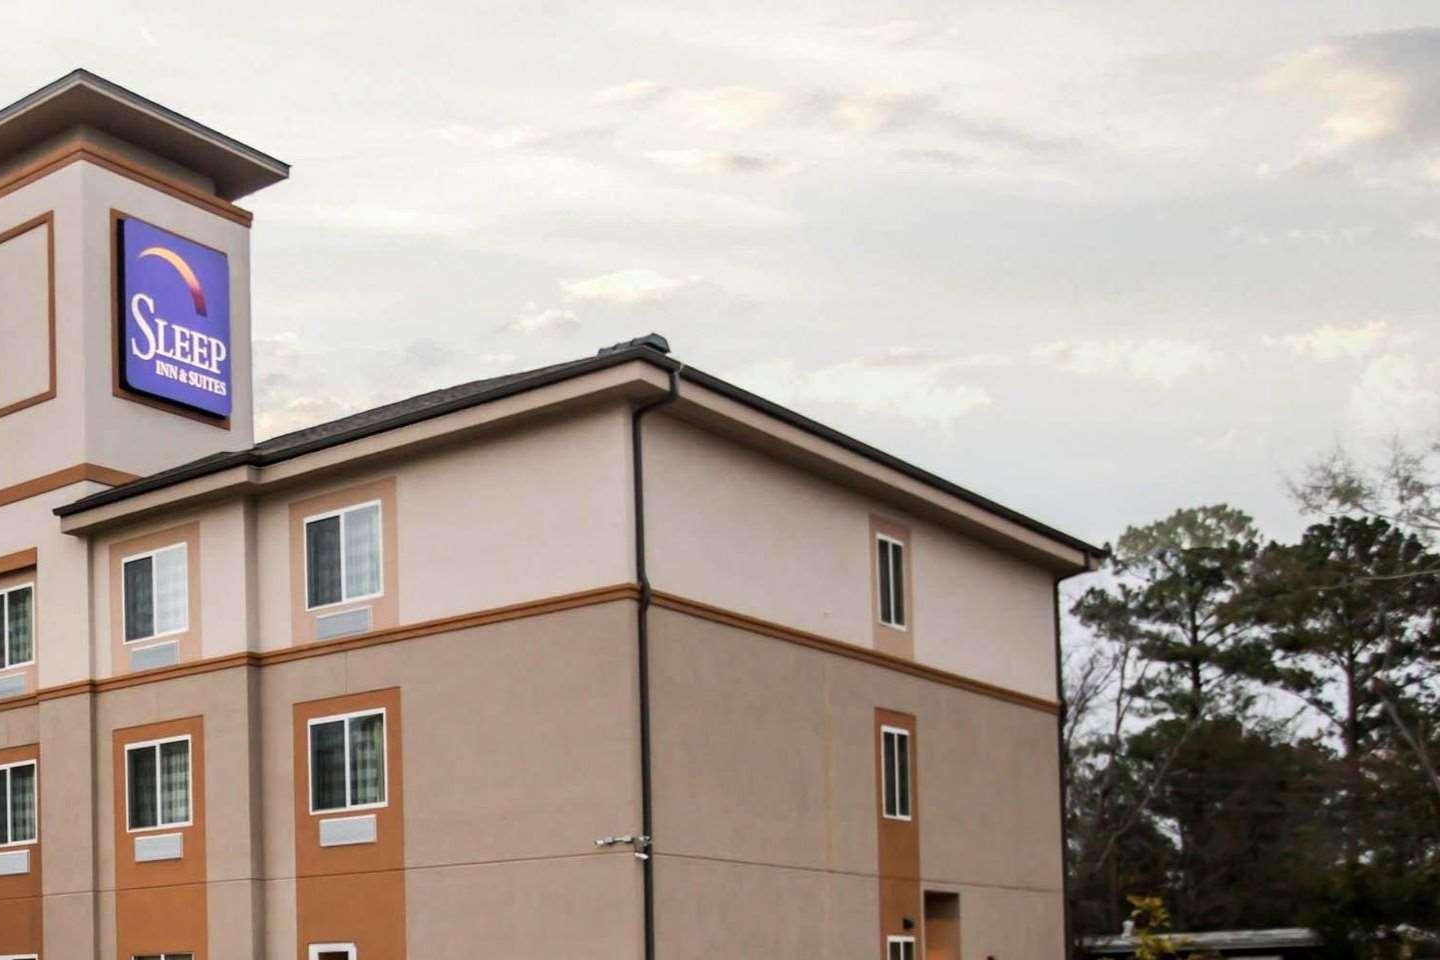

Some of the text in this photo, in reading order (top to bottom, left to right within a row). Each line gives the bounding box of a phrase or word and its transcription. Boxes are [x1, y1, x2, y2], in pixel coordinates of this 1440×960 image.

[131, 293, 226, 374] SLEEP
[156, 360, 227, 396] INN & SUITES
